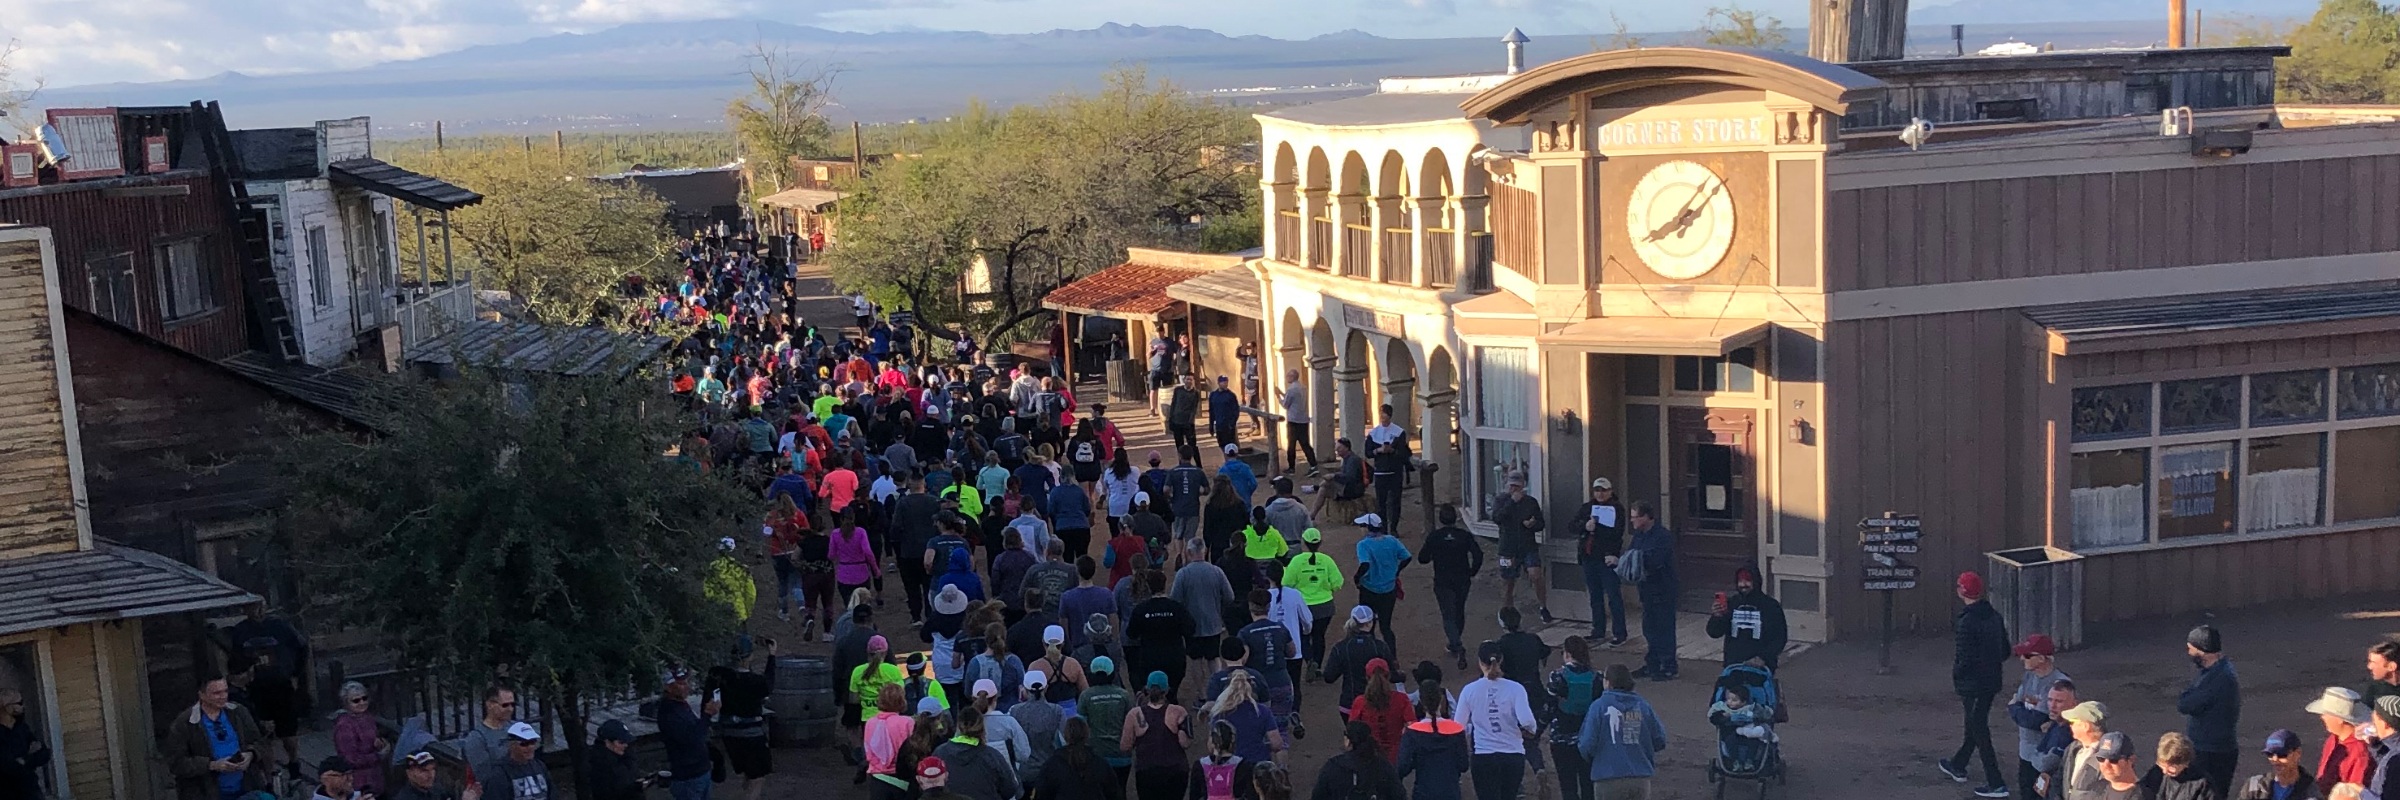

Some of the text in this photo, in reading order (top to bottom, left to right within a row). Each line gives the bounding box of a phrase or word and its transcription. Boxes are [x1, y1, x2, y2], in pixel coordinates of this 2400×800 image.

[1599, 115, 1763, 146] CORNER STORE
[1897, 519, 1920, 527] PLAZA
[1879, 545, 1895, 553] FOR
[1896, 545, 1918, 553] GOLD
[1867, 568, 1915, 577] TRAIN RIDE
[1899, 581, 1916, 589] LOOP
